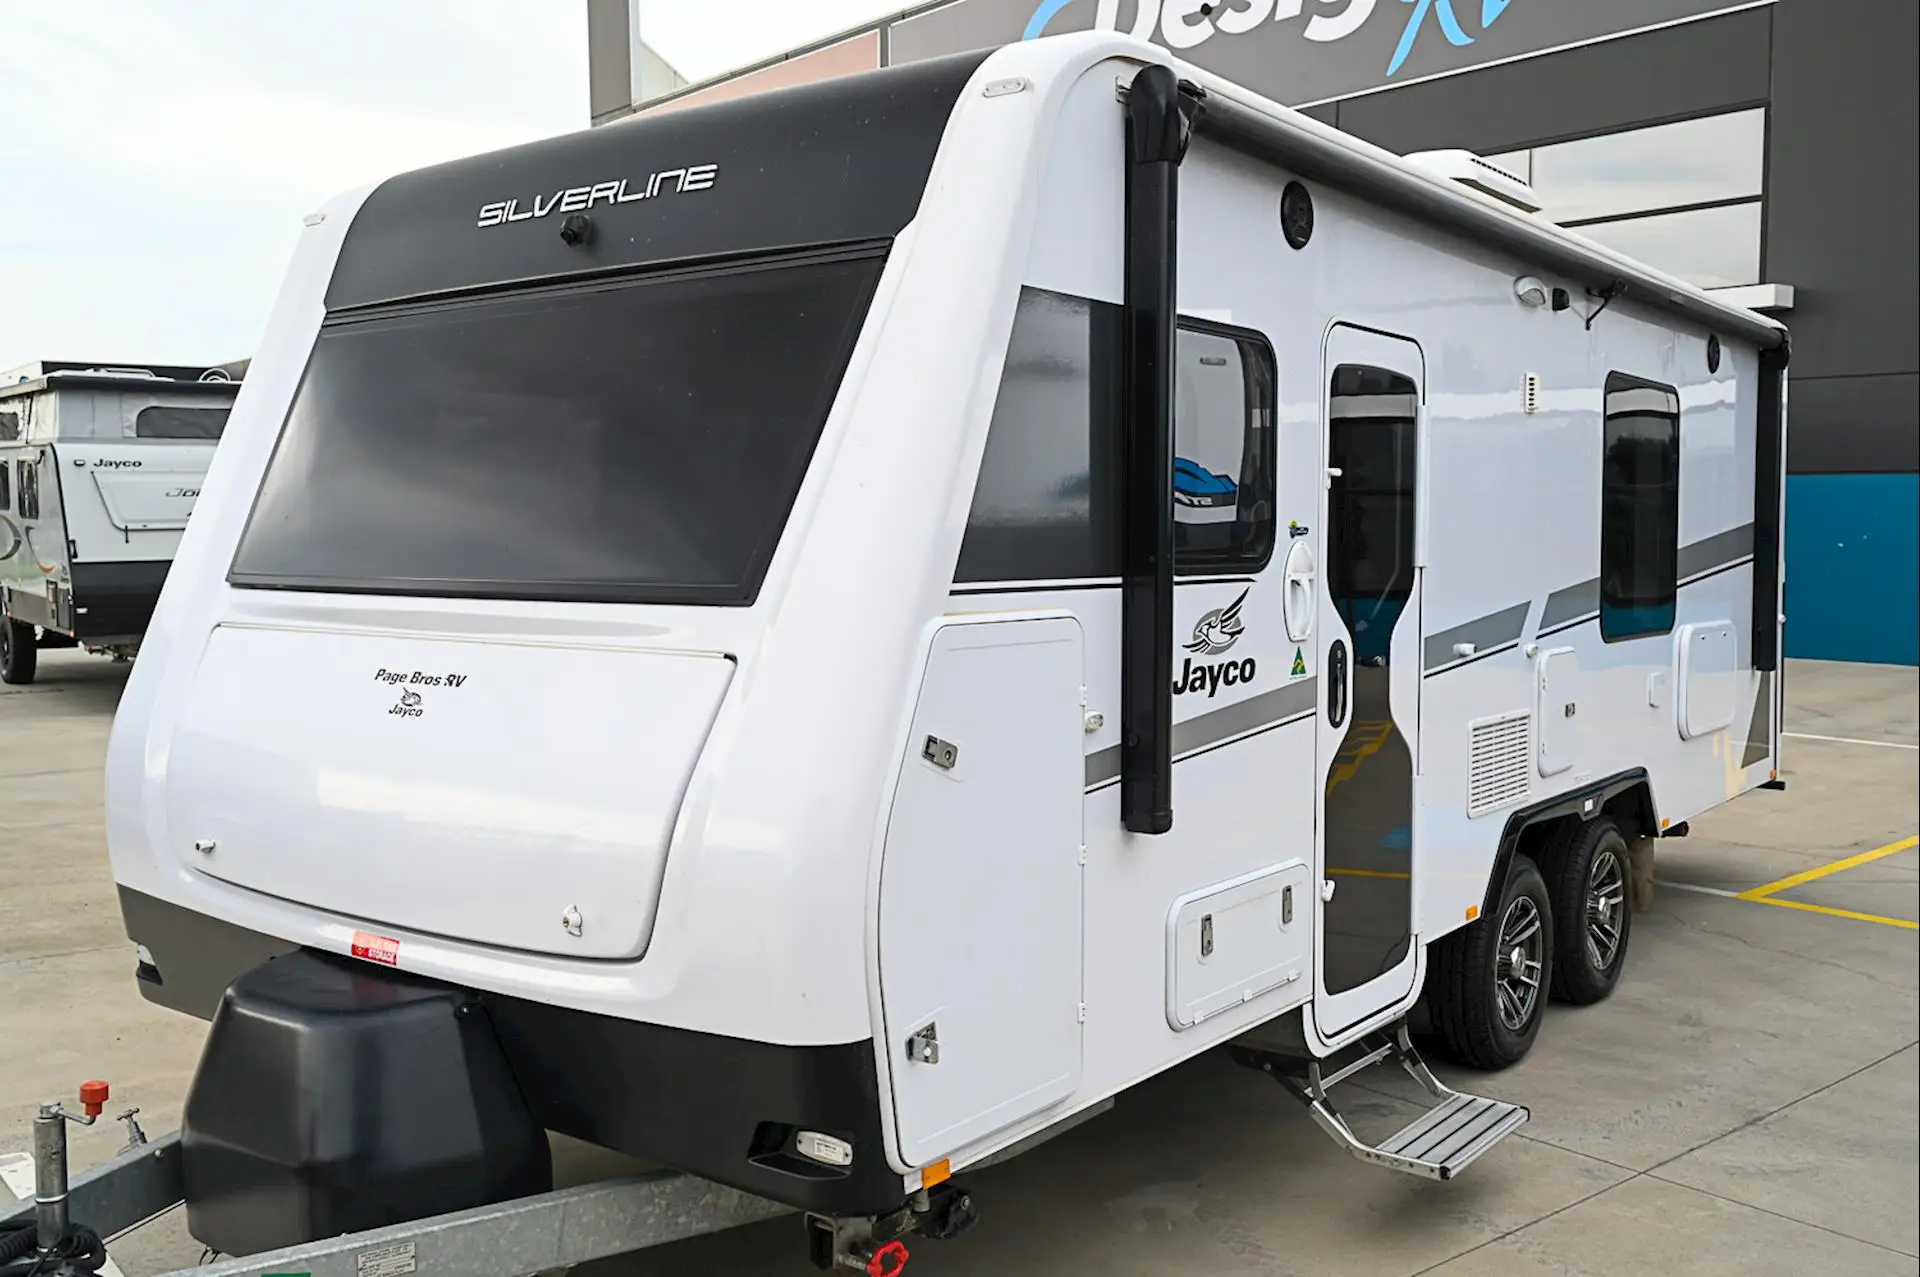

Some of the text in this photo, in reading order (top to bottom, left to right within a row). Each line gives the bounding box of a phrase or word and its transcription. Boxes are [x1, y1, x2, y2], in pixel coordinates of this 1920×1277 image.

[477, 164, 719, 228] SILVERLINE
[93, 458, 142, 470] Jayco
[374, 668, 408, 685] Page
[410, 671, 442, 686] Bros
[1172, 657, 1256, 698] Jayco
[388, 703, 424, 718] Jayco
